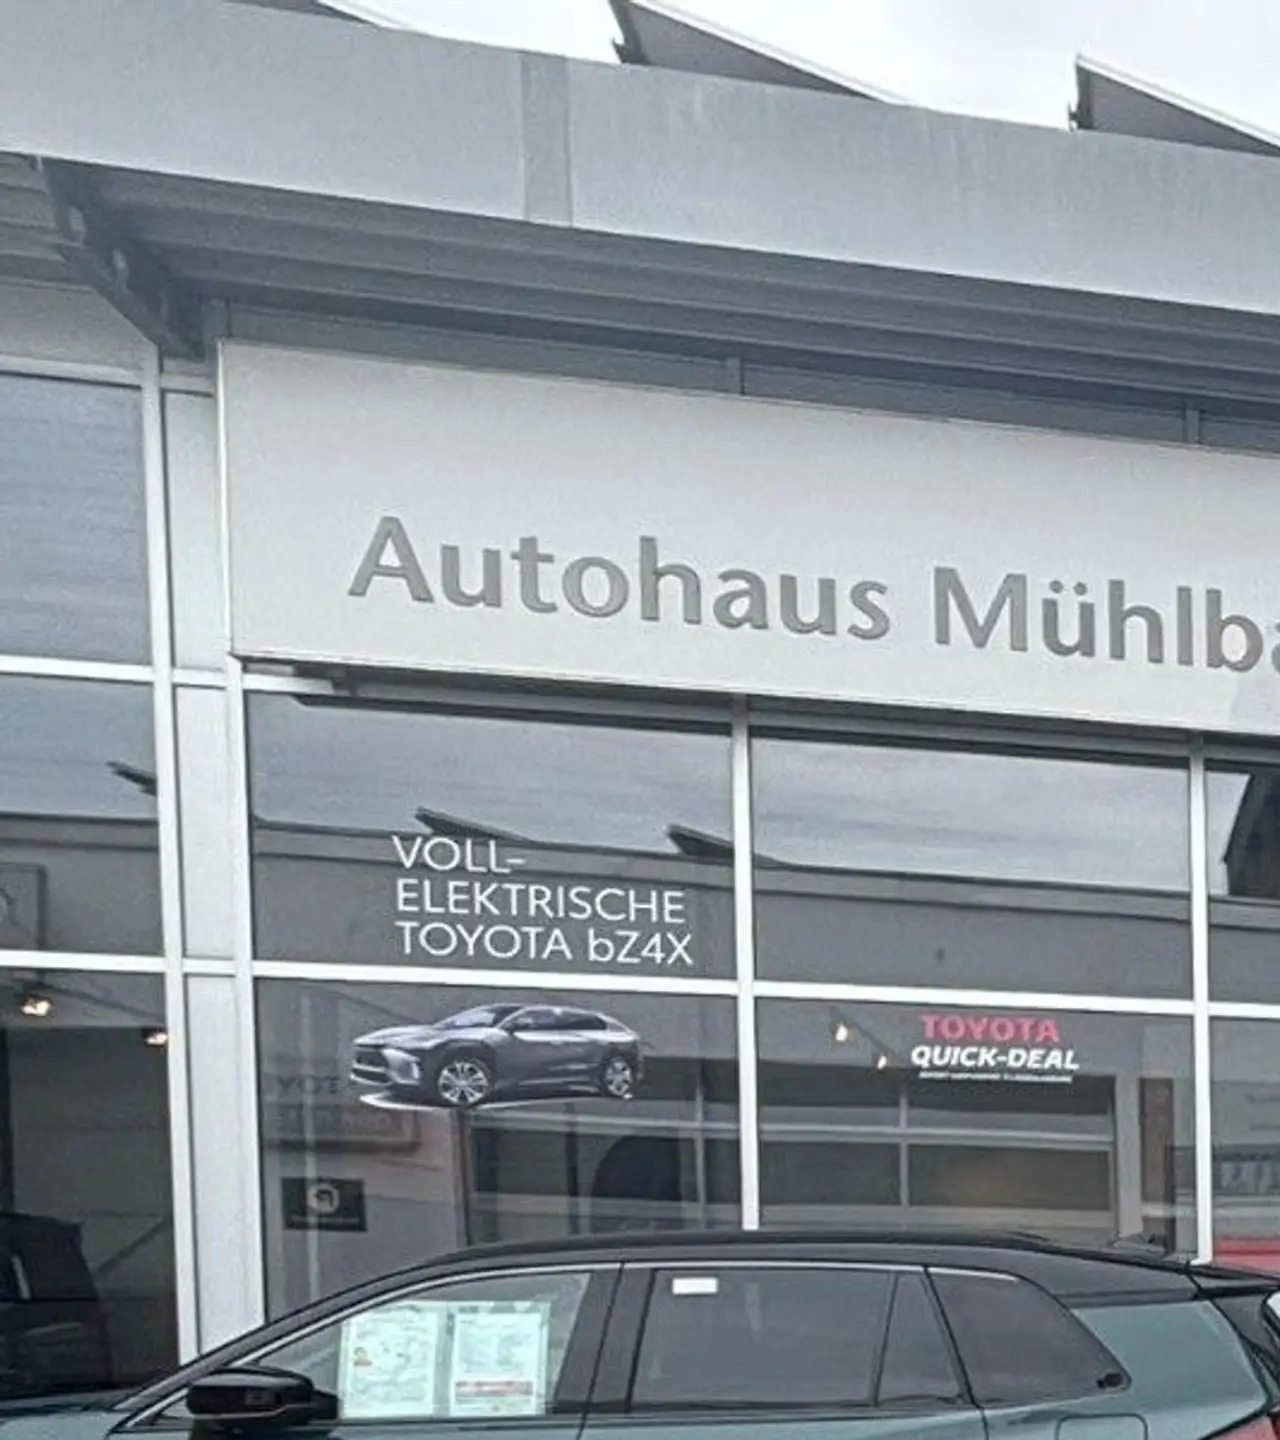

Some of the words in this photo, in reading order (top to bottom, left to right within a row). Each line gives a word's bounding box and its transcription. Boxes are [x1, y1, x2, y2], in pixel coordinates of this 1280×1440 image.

[348, 515, 891, 641] Autohaus
[392, 836, 525, 873] VOLL-
[397, 878, 686, 923] ELEKTRISCHE
[395, 921, 572, 960] TOYOTA
[588, 927, 694, 965] bZ4X
[921, 1014, 1060, 1042] TOYOTA
[910, 1045, 1080, 1070] QUICK-DEAL
